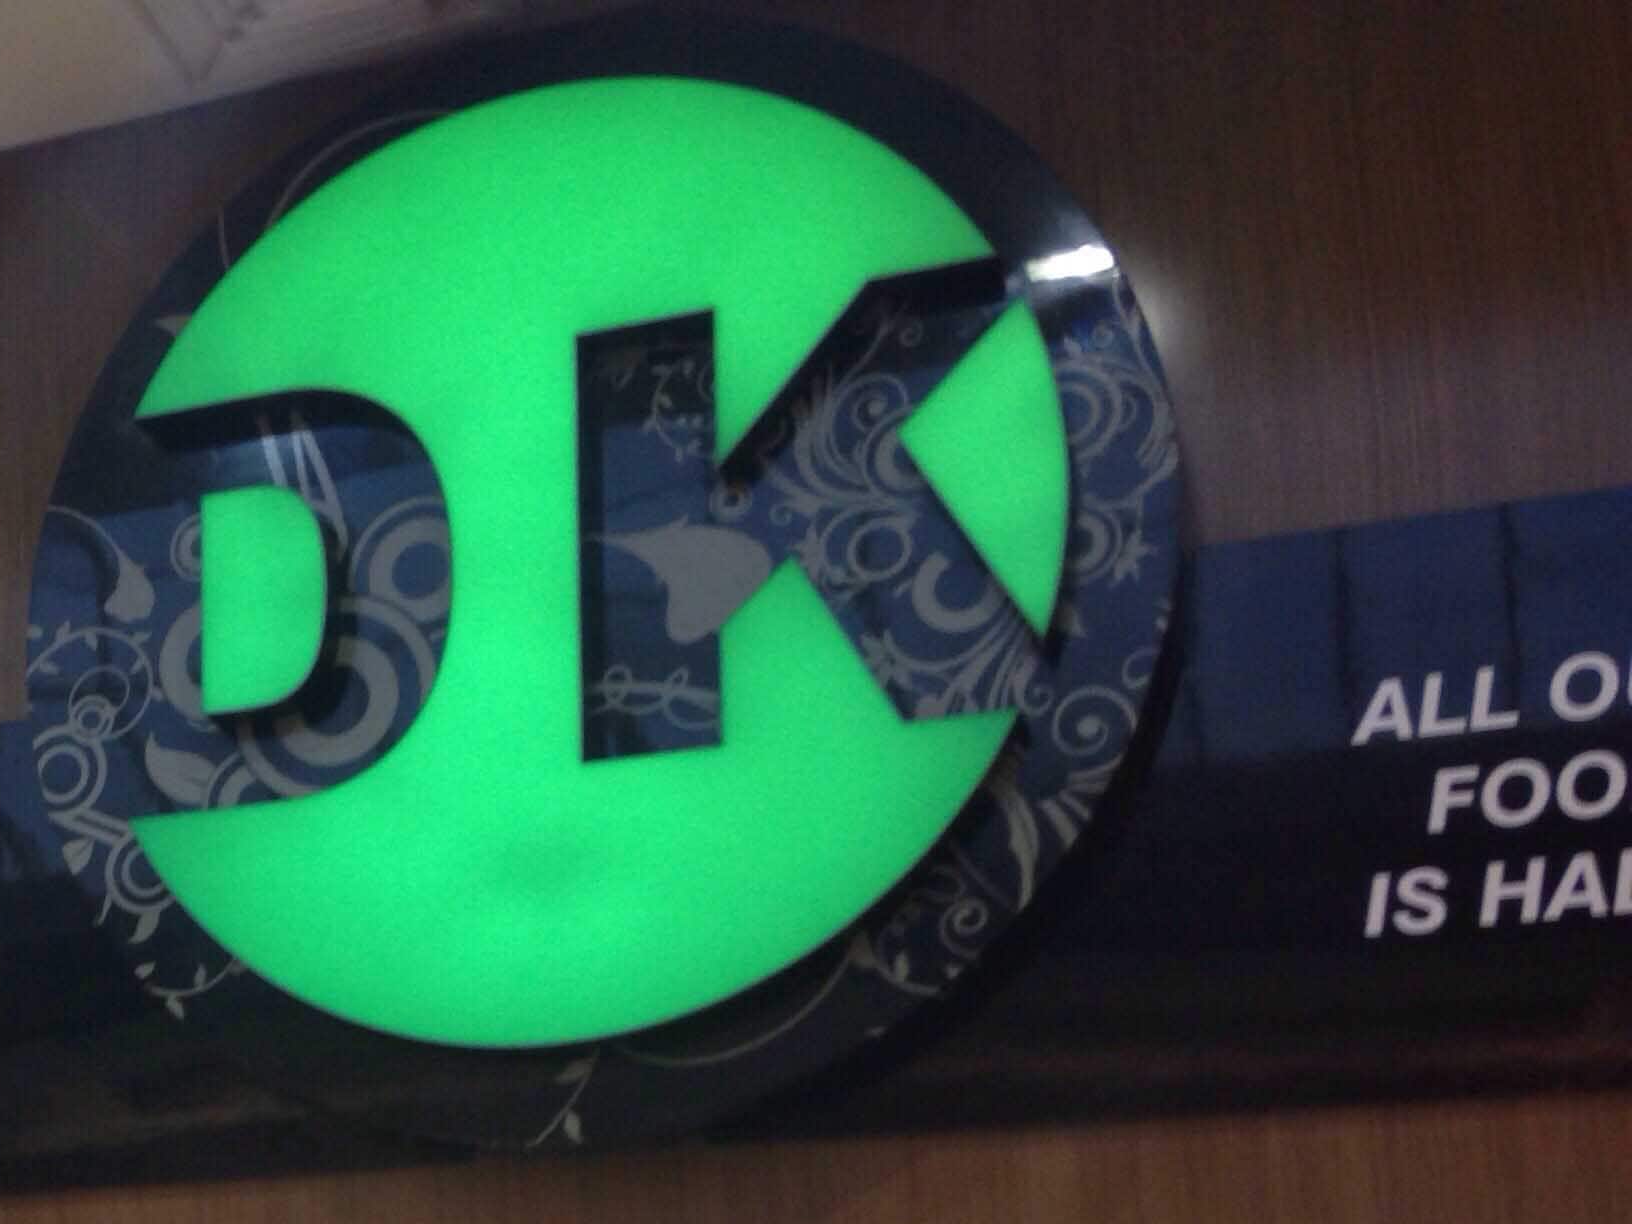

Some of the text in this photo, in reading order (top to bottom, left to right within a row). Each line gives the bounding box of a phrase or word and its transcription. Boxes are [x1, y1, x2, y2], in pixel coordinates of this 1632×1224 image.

[1350, 650, 1632, 747] ALL O
[1427, 749, 1632, 836] FOO
[1364, 867, 1449, 939] IS
